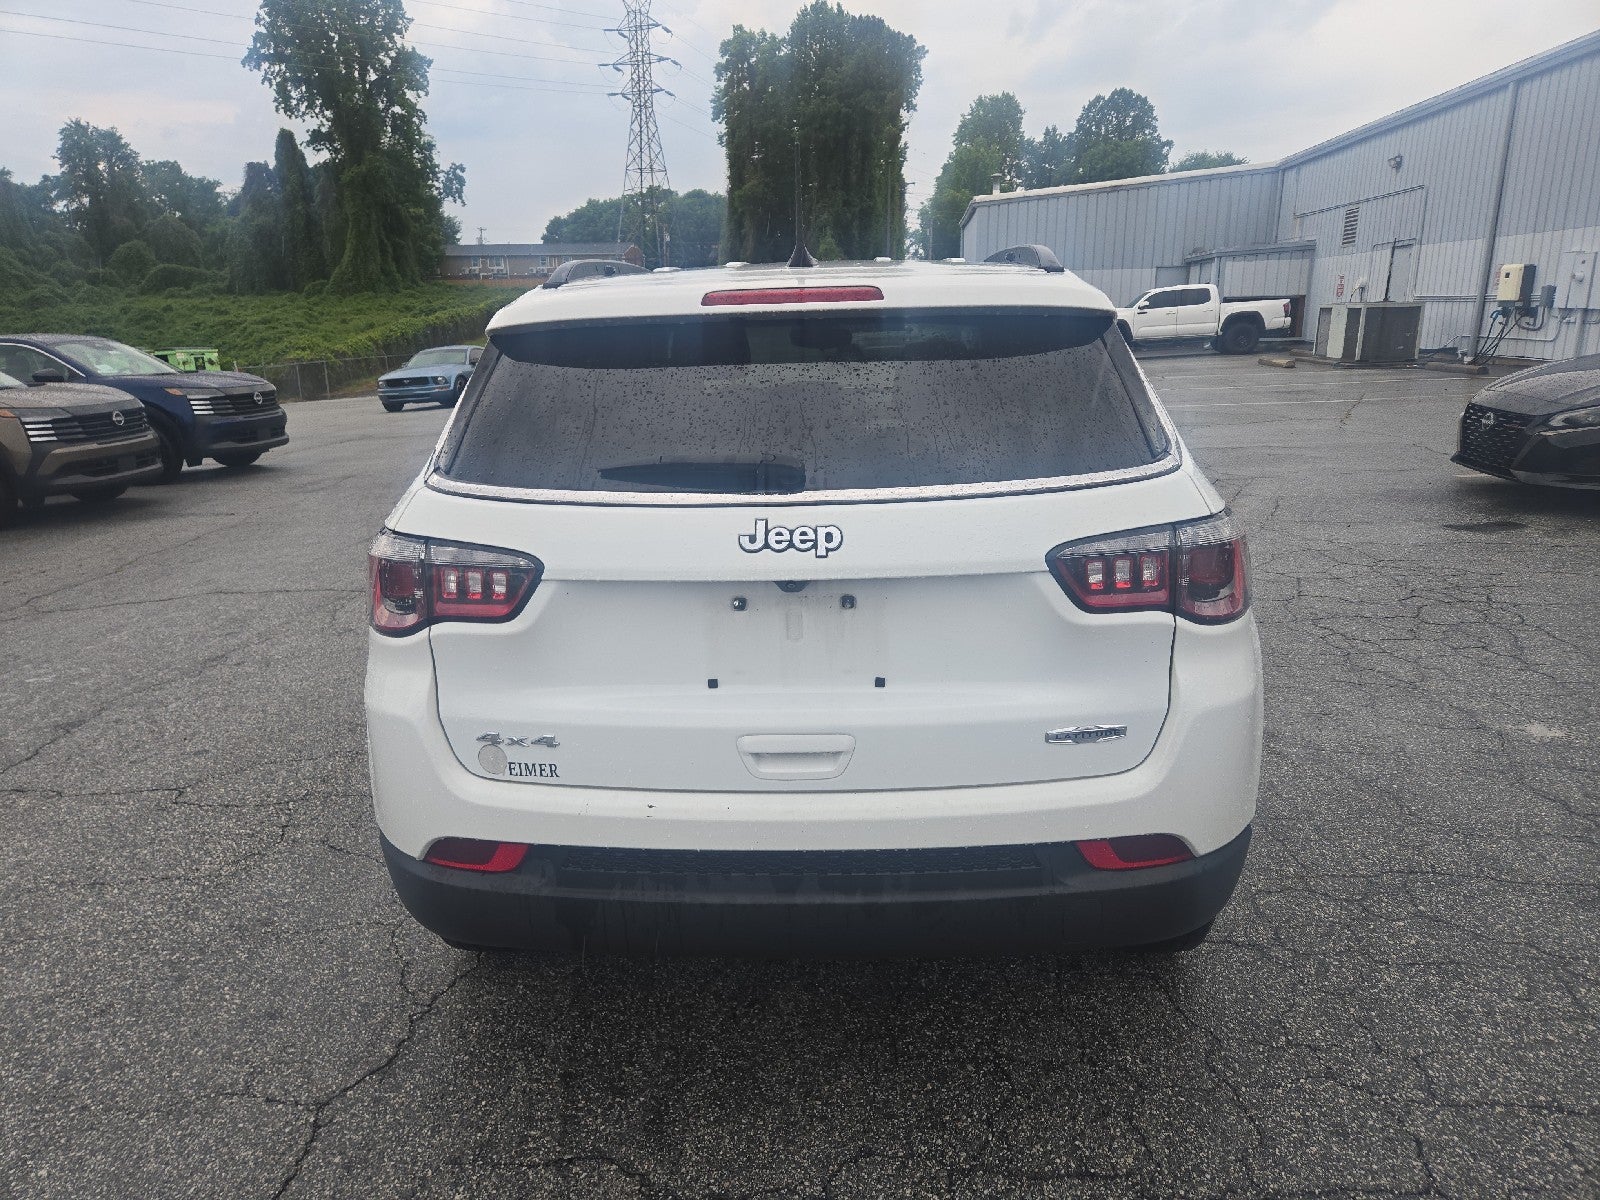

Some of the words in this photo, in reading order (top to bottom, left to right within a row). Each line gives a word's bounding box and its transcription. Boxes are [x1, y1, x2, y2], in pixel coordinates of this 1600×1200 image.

[738, 518, 843, 558] Jeep
[1054, 727, 1122, 741] LATITUDE
[507, 761, 560, 778] EIMER
